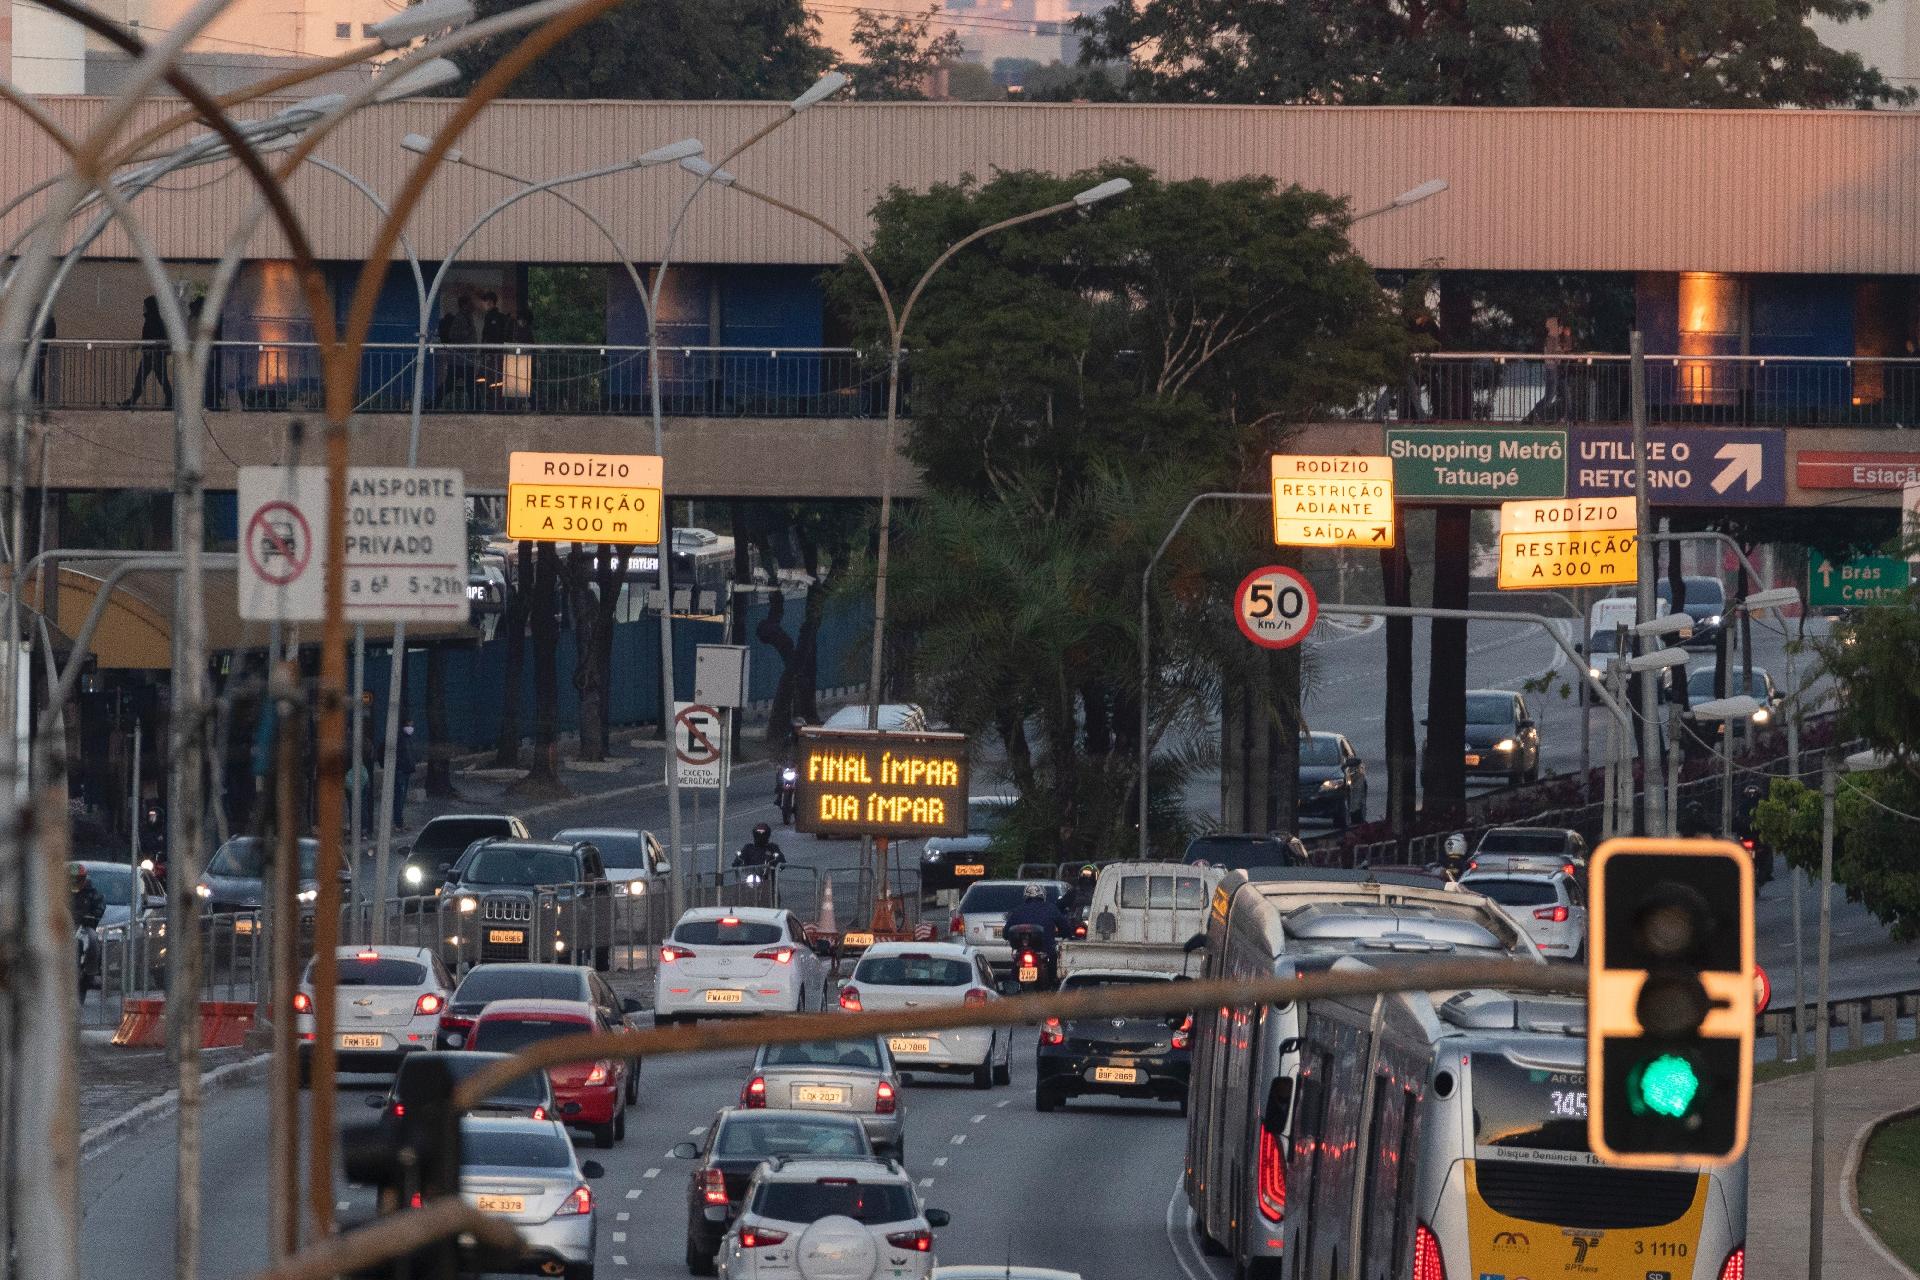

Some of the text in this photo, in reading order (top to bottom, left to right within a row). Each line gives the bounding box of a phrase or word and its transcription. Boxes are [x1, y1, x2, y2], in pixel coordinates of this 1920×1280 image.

[1390, 440, 1562, 463] Shopping Metrô
[1580, 441, 1690, 461] UTILIE O
[544, 458, 629, 478] RODÍZIO
[1296, 458, 1369, 473] RODÍZIO
[1434, 467, 1519, 489] Tatuapé
[1853, 466, 1920, 488] Estaçã
[1283, 483, 1383, 500] RESTRIÇÃO
[526, 493, 645, 513] RESTRIÇÃO
[1296, 502, 1373, 515] ADIANTE
[1535, 504, 1618, 523] RODÍZIO
[542, 516, 628, 533] A 300 m
[1303, 523, 1357, 539] SAÍDA
[345, 536, 433, 554] PRIVADO
[1516, 536, 1631, 557] RESTRIÇÃO
[1532, 562, 1615, 577] A 300 m
[1842, 565, 1881, 580] Brás
[1250, 584, 1303, 619] 50
[1258, 619, 1292, 630] km/h
[808, 751, 959, 786] FINAL ÍMPAR
[820, 792, 944, 824] DIA ÍMPAR
[1497, 1148, 1530, 1160] Disque
[1533, 1150, 1578, 1162] Denúncia
[1634, 1241, 1688, 1258] 3 1110
